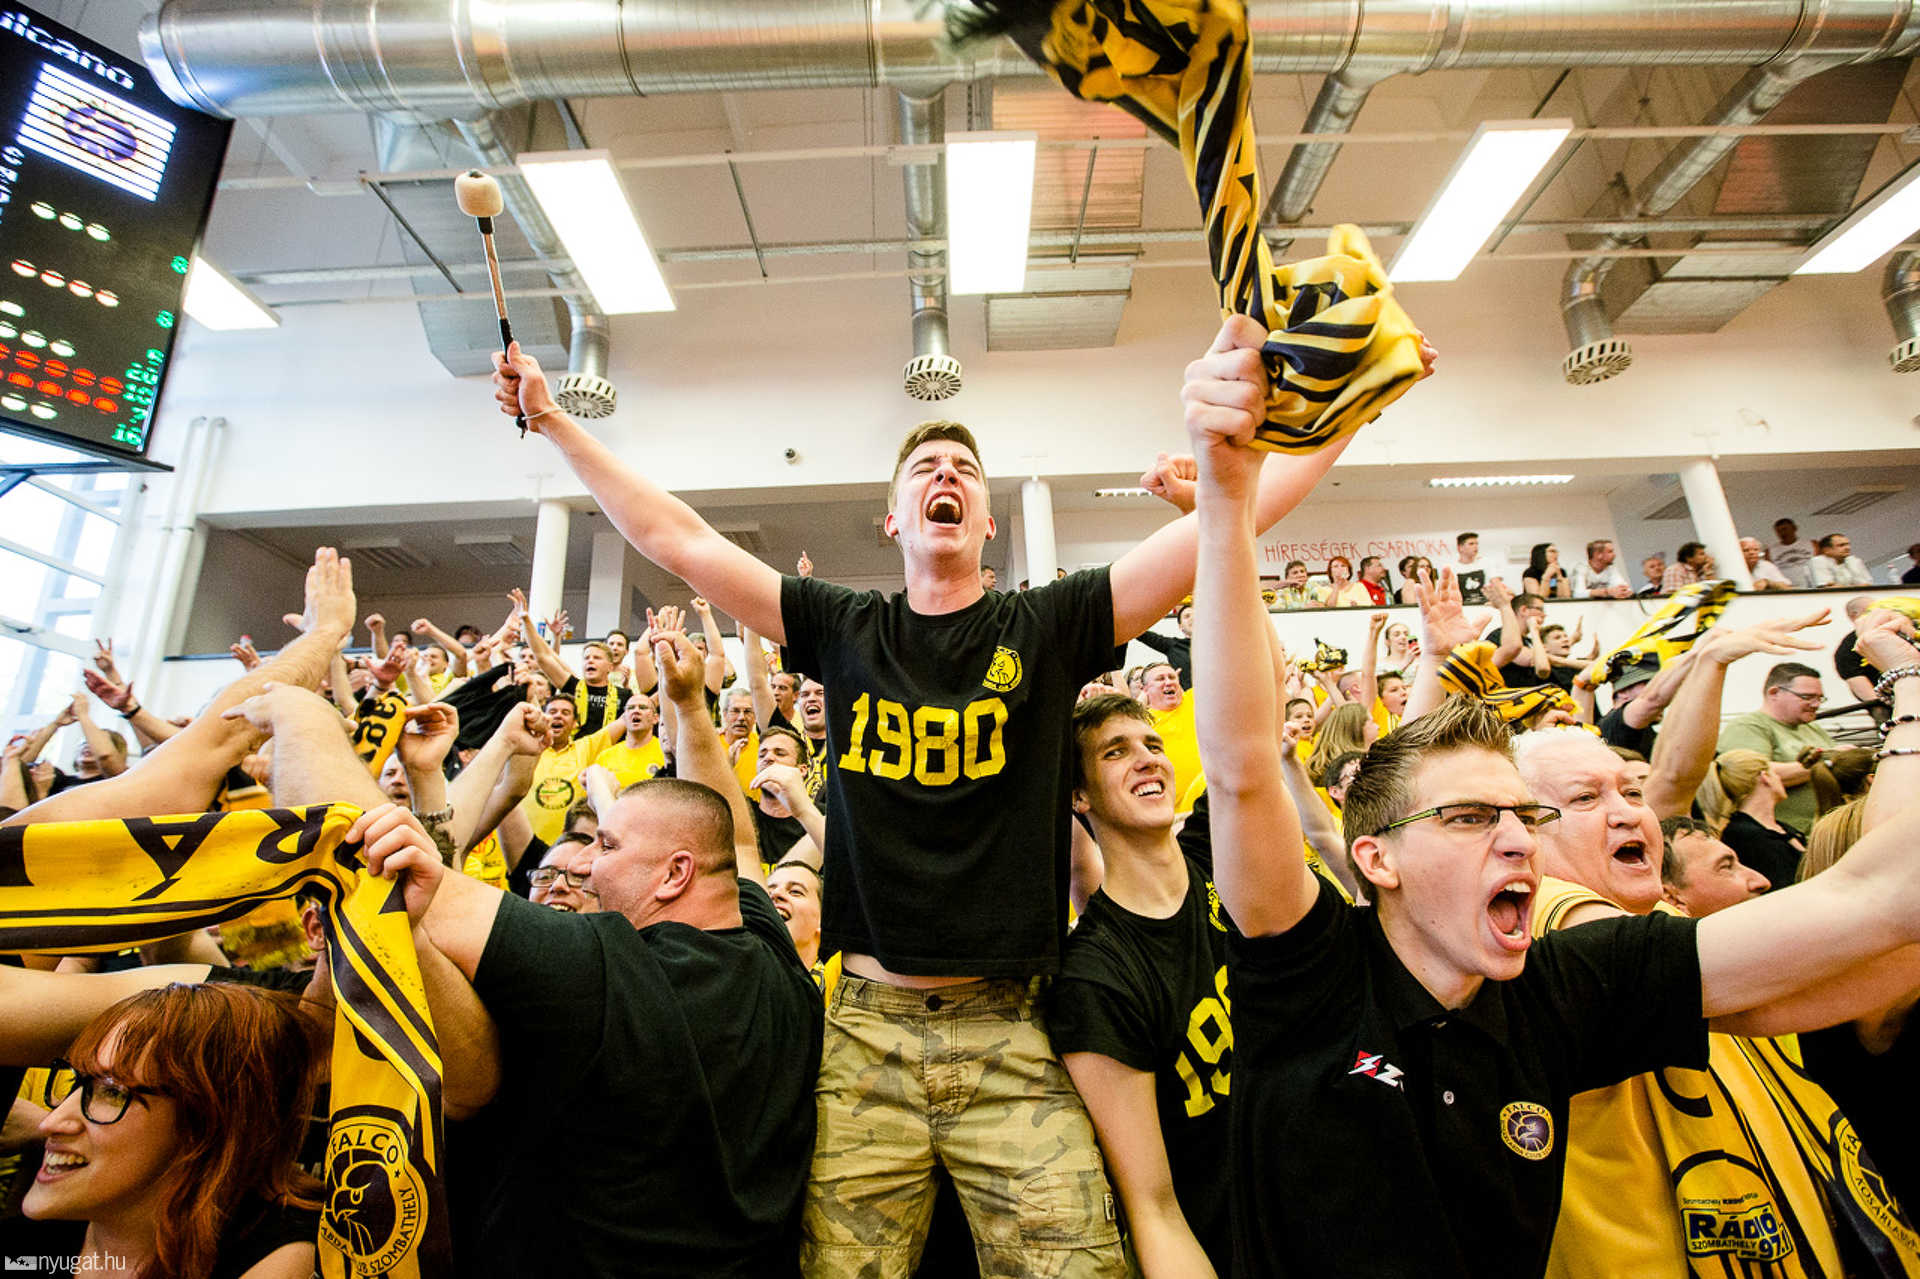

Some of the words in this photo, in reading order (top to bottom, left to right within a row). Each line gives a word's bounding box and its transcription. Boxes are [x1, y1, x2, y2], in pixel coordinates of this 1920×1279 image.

[1367, 539, 1452, 560] CSARNOKA
[838, 692, 1009, 786] 1980
[371, 1187, 417, 1274] SZOMBATHELY
[1689, 1207, 1778, 1240] RÁDIÓ
[1691, 1239, 1758, 1251] SZOMBATHELY
